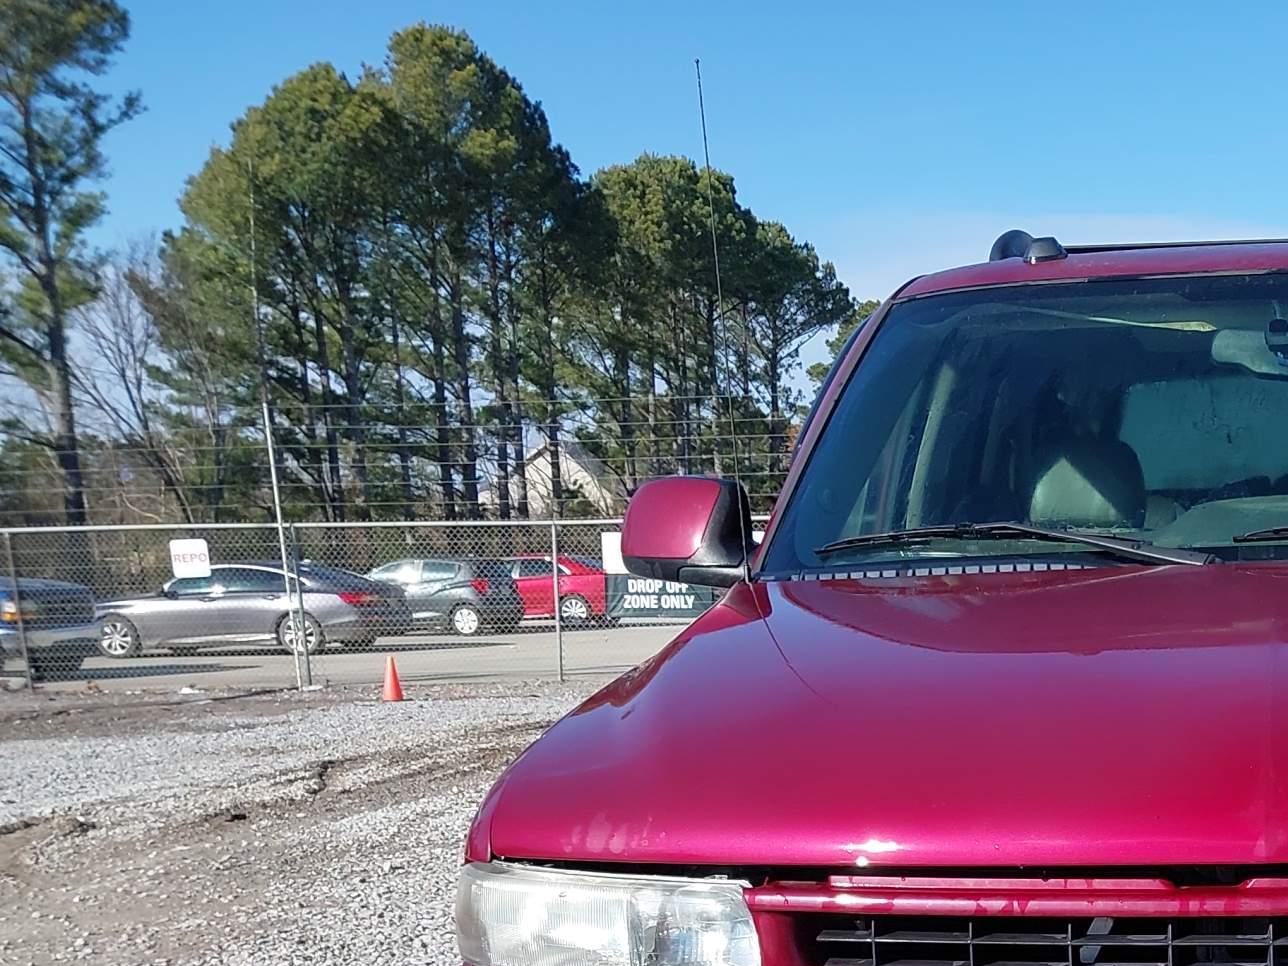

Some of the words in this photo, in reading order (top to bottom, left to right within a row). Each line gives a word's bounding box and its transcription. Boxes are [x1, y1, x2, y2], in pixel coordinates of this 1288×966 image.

[173, 552, 208, 563] REPO
[627, 579, 663, 593] DROP
[623, 594, 659, 609] ZONE
[660, 594, 695, 609] ONLY
